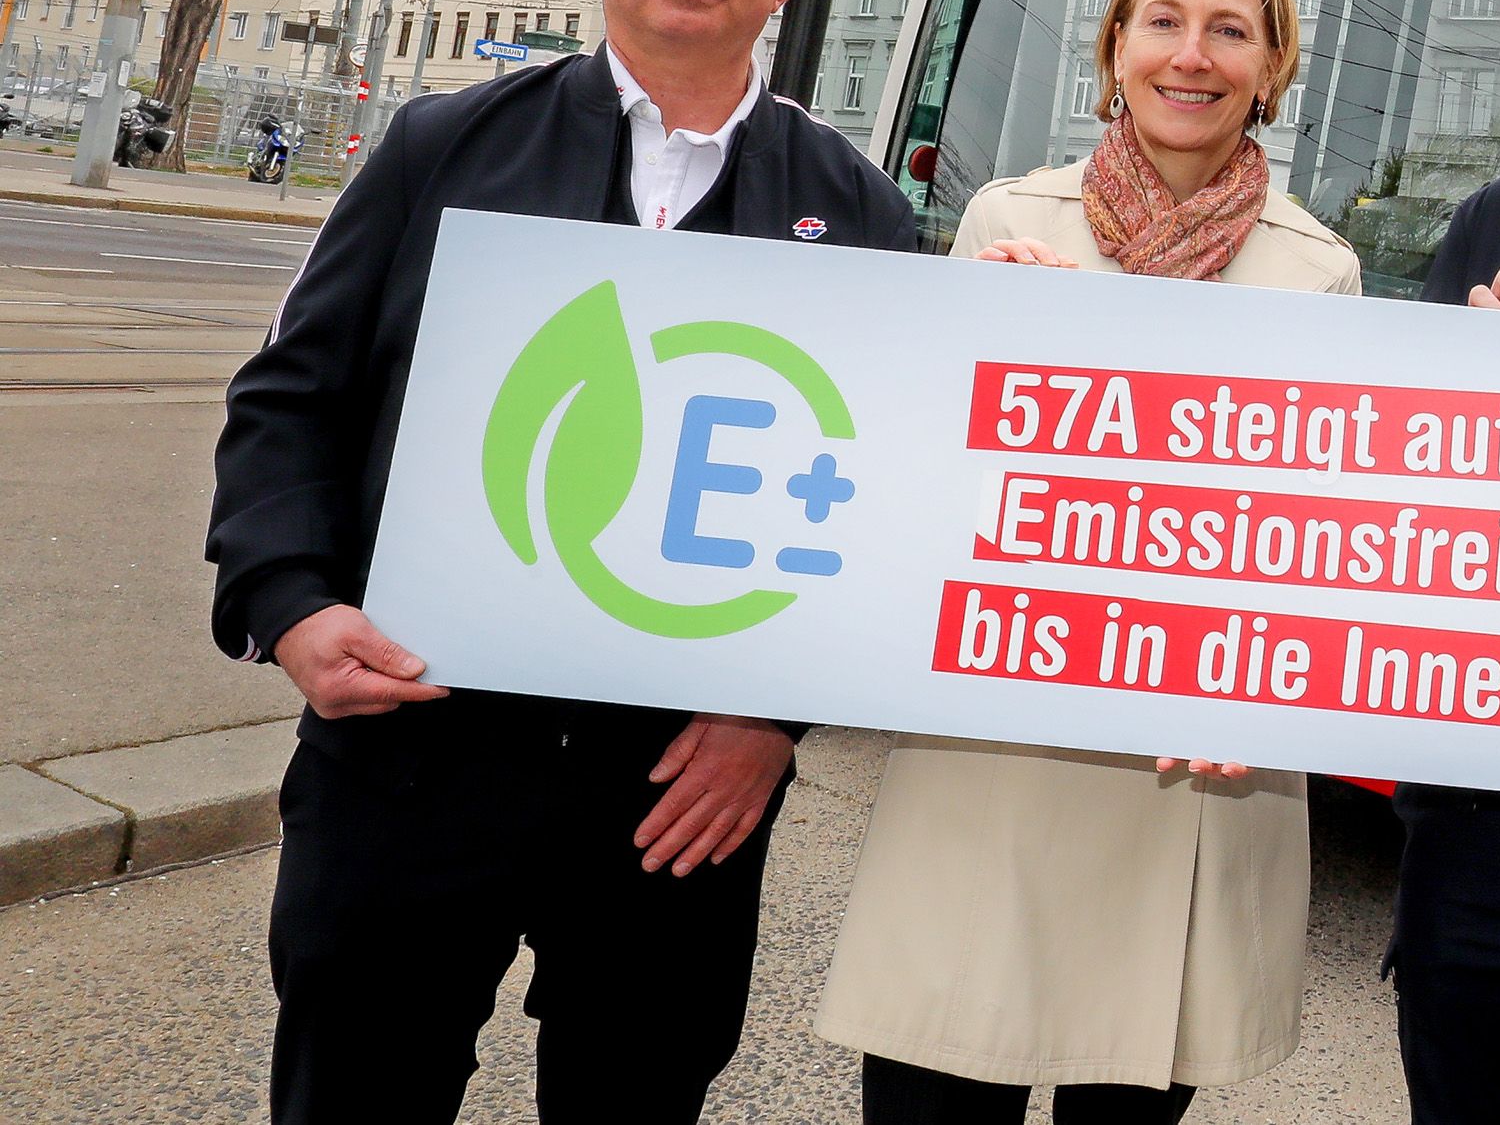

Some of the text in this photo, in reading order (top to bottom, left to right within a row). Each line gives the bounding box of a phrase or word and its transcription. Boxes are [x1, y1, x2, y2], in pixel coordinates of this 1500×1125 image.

[491, 45, 522, 57] EINBAHN
[995, 371, 1139, 455] 57A
[1167, 385, 1380, 485] steigt
[957, 588, 1070, 677] bis
[1098, 601, 1168, 688] in
[1197, 613, 1312, 702] die
